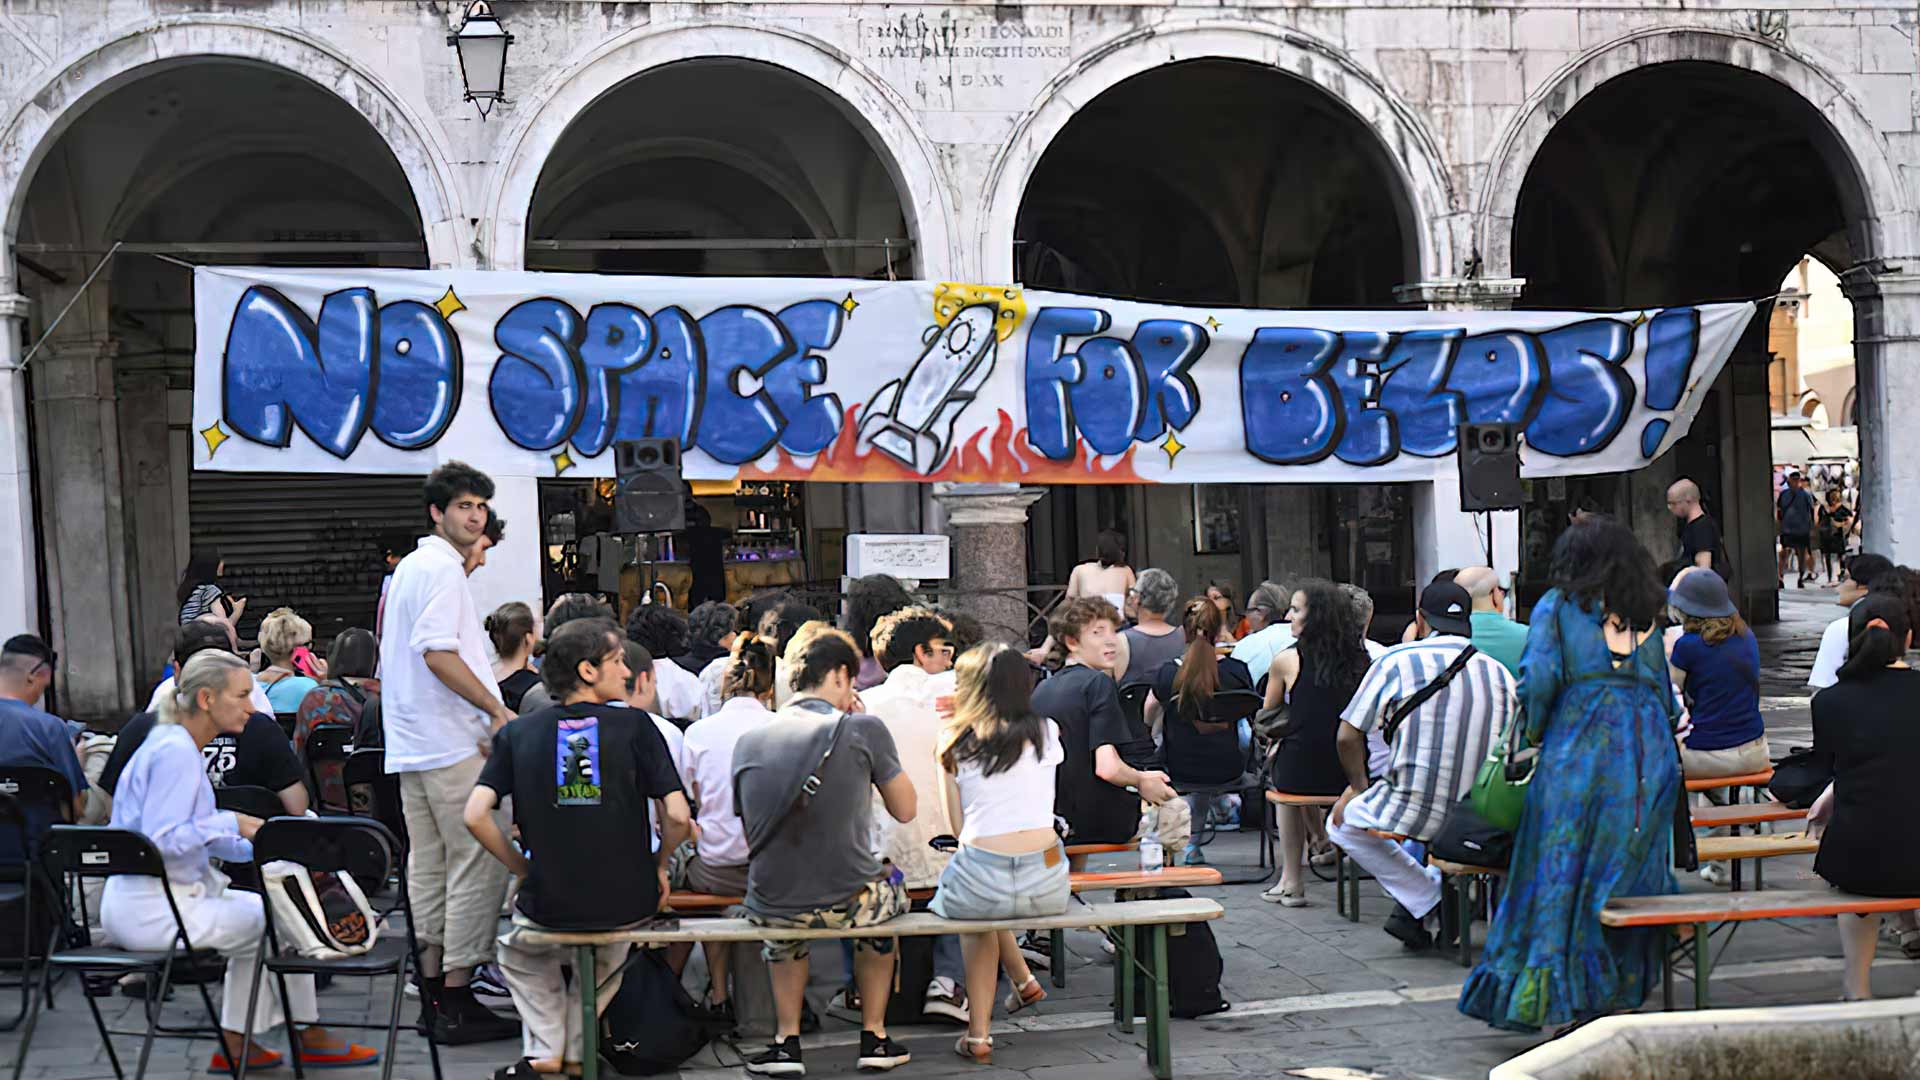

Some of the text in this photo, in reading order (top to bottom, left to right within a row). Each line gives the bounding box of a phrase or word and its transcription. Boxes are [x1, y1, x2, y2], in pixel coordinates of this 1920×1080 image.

[222, 284, 463, 460] NO
[487, 296, 845, 465] SPACE
[1025, 306, 1210, 459] FOR
[202, 746, 237, 772] 75
